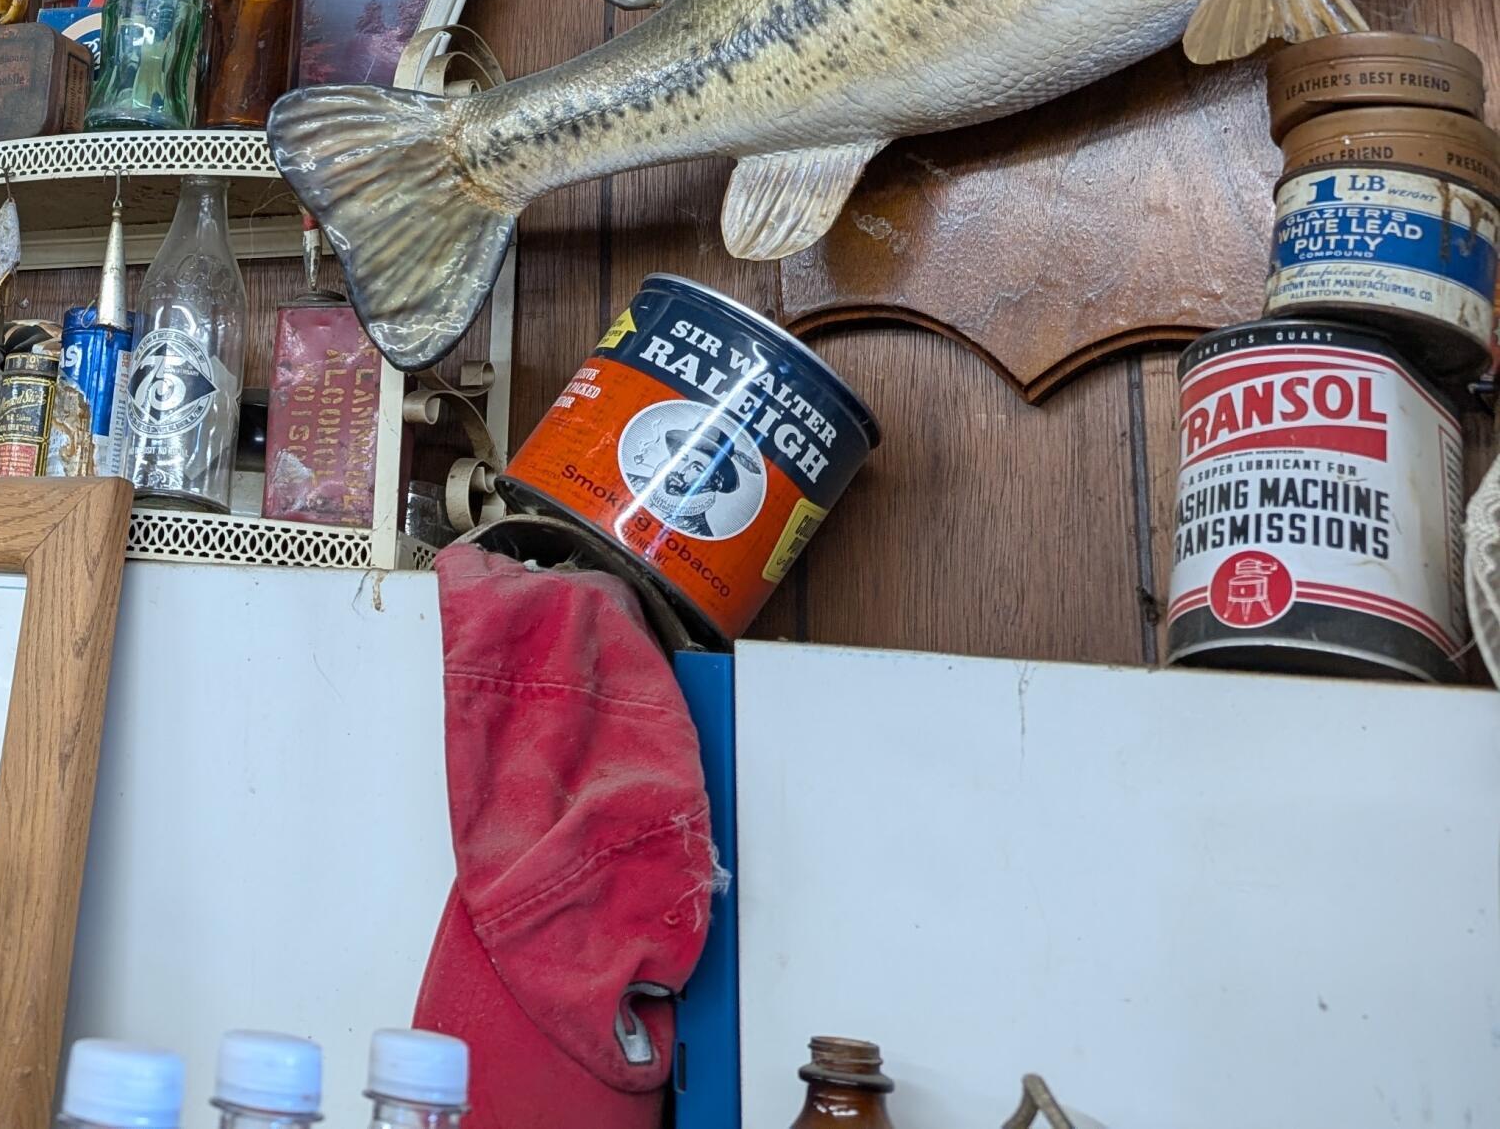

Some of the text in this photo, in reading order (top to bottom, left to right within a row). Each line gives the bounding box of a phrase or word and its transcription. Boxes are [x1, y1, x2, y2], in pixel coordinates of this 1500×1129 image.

[1286, 72, 1450, 100] LEATHER'S BEST FRIEND
[1340, 146, 1393, 162] FRIEND
[1306, 175, 1342, 205] 1
[1388, 188, 1437, 202] WEIGHT
[1286, 208, 1407, 226] GLAZIER'S
[1278, 218, 1423, 245] WHITE LEAD
[1294, 235, 1383, 254] PUTTY
[1298, 250, 1374, 260] COMPOUND
[1288, 265, 1373, 280] Manufactured
[1307, 279, 1330, 289] PAINT
[1198, 342, 1219, 359] ONE
[1276, 331, 1333, 342] QUART
[670, 320, 837, 448] SIR WALTER
[287, 363, 317, 462] POISO
[311, 349, 348, 488] ALCOHOL
[639, 335, 829, 484] RALEIGH
[1197, 463, 1234, 483] SUPER
[1238, 457, 1321, 474] LUBRICANT
[1327, 462, 1357, 477] FOR
[1177, 477, 1389, 529] ASHING MACHINE
[561, 464, 651, 532] Smokig
[660, 523, 731, 598] Tobacco
[1174, 512, 1389, 565] RANSMISSIONS
